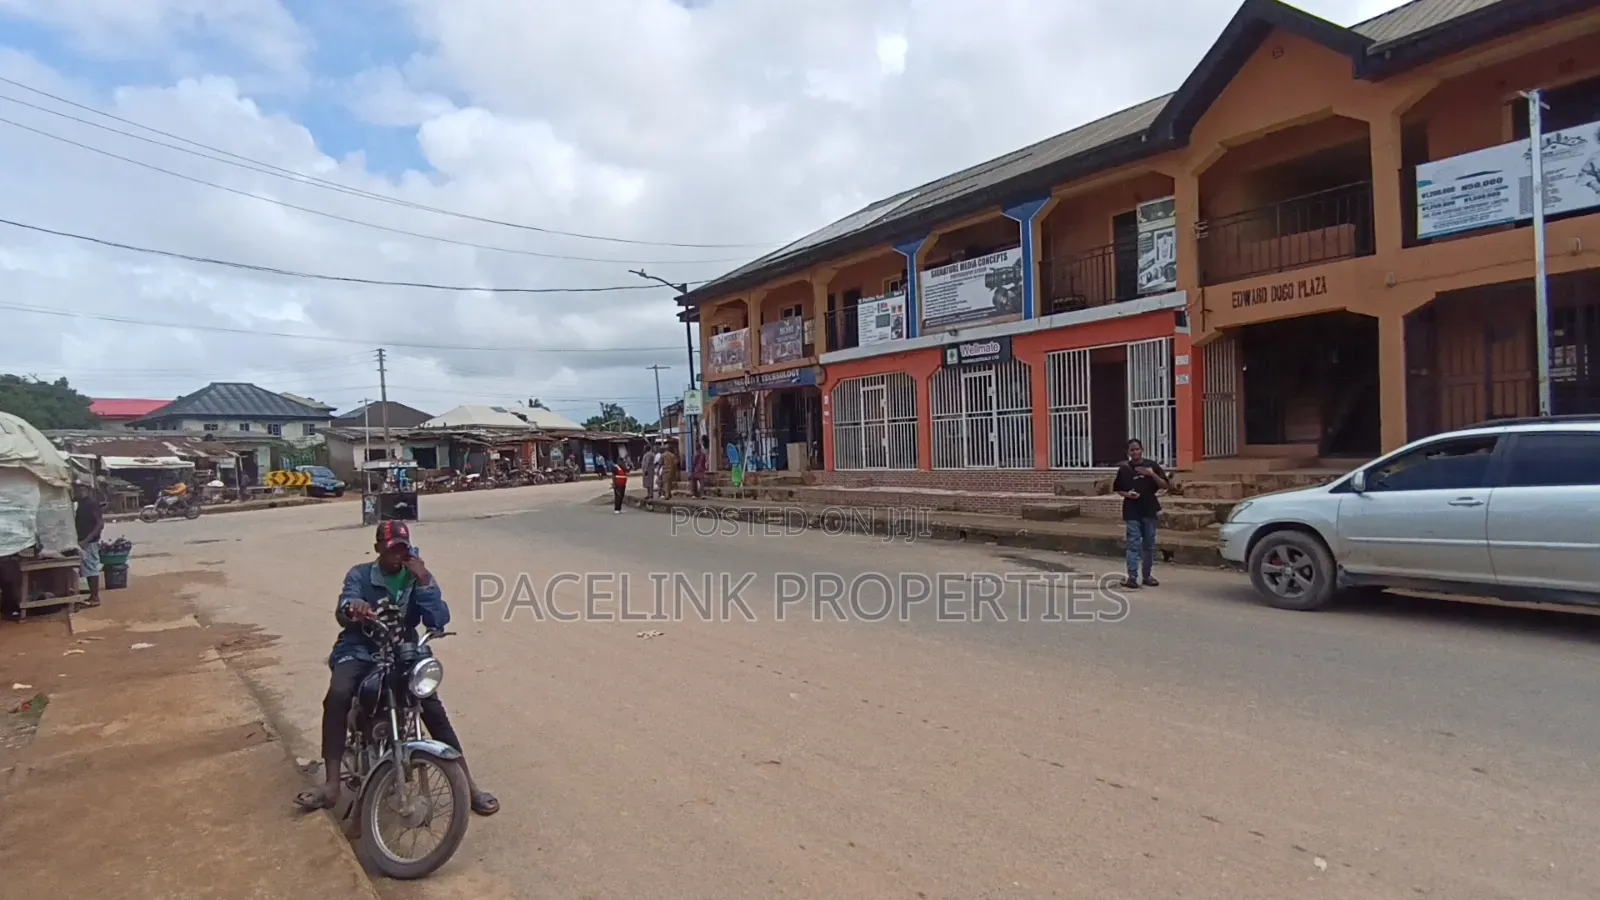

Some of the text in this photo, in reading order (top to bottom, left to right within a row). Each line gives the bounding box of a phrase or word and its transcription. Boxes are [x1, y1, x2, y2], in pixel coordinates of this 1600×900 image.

[931, 252, 1008, 278] SIGNATURE MEDIA CONCEPTS
[1231, 275, 1328, 309] EDWARD DOGO PLAZA
[959, 341, 1001, 357] Wellmate
[761, 368, 800, 382] TECHNOLOGY
